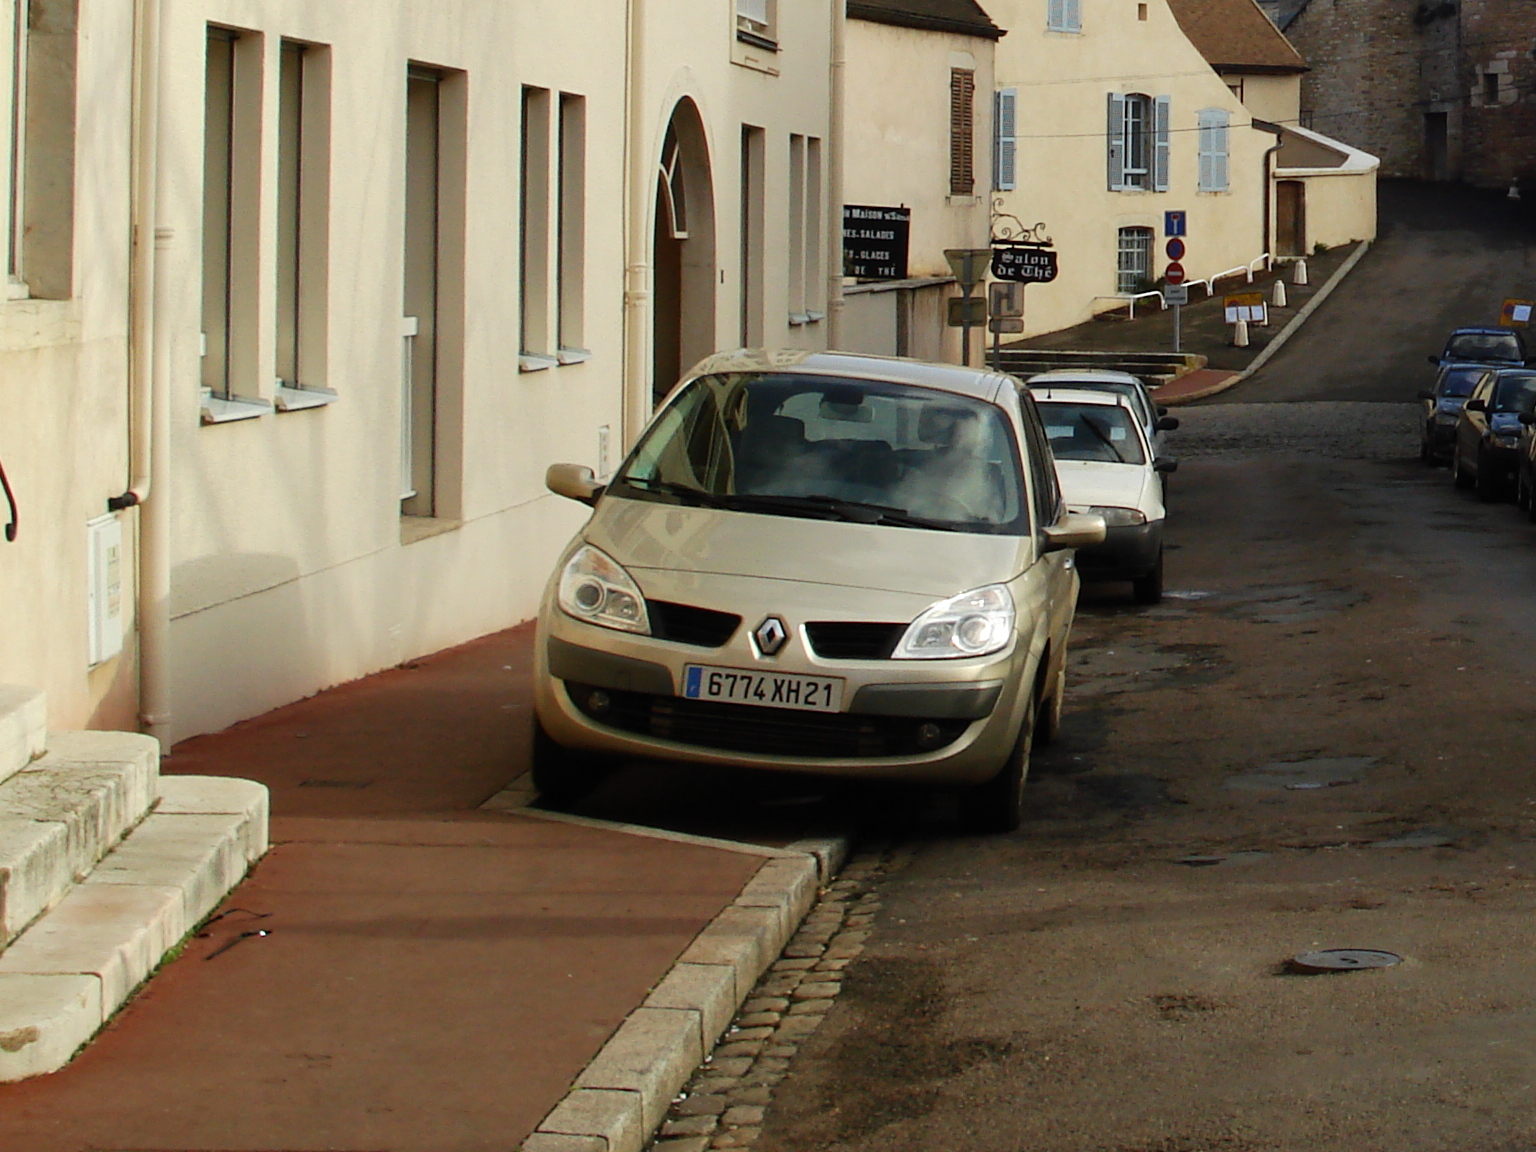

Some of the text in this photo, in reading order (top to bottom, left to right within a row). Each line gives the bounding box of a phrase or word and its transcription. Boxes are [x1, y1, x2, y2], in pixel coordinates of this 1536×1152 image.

[1001, 251, 1048, 265] Salon
[997, 264, 1052, 280] de Thé
[708, 672, 832, 706] 6774 XH 21
